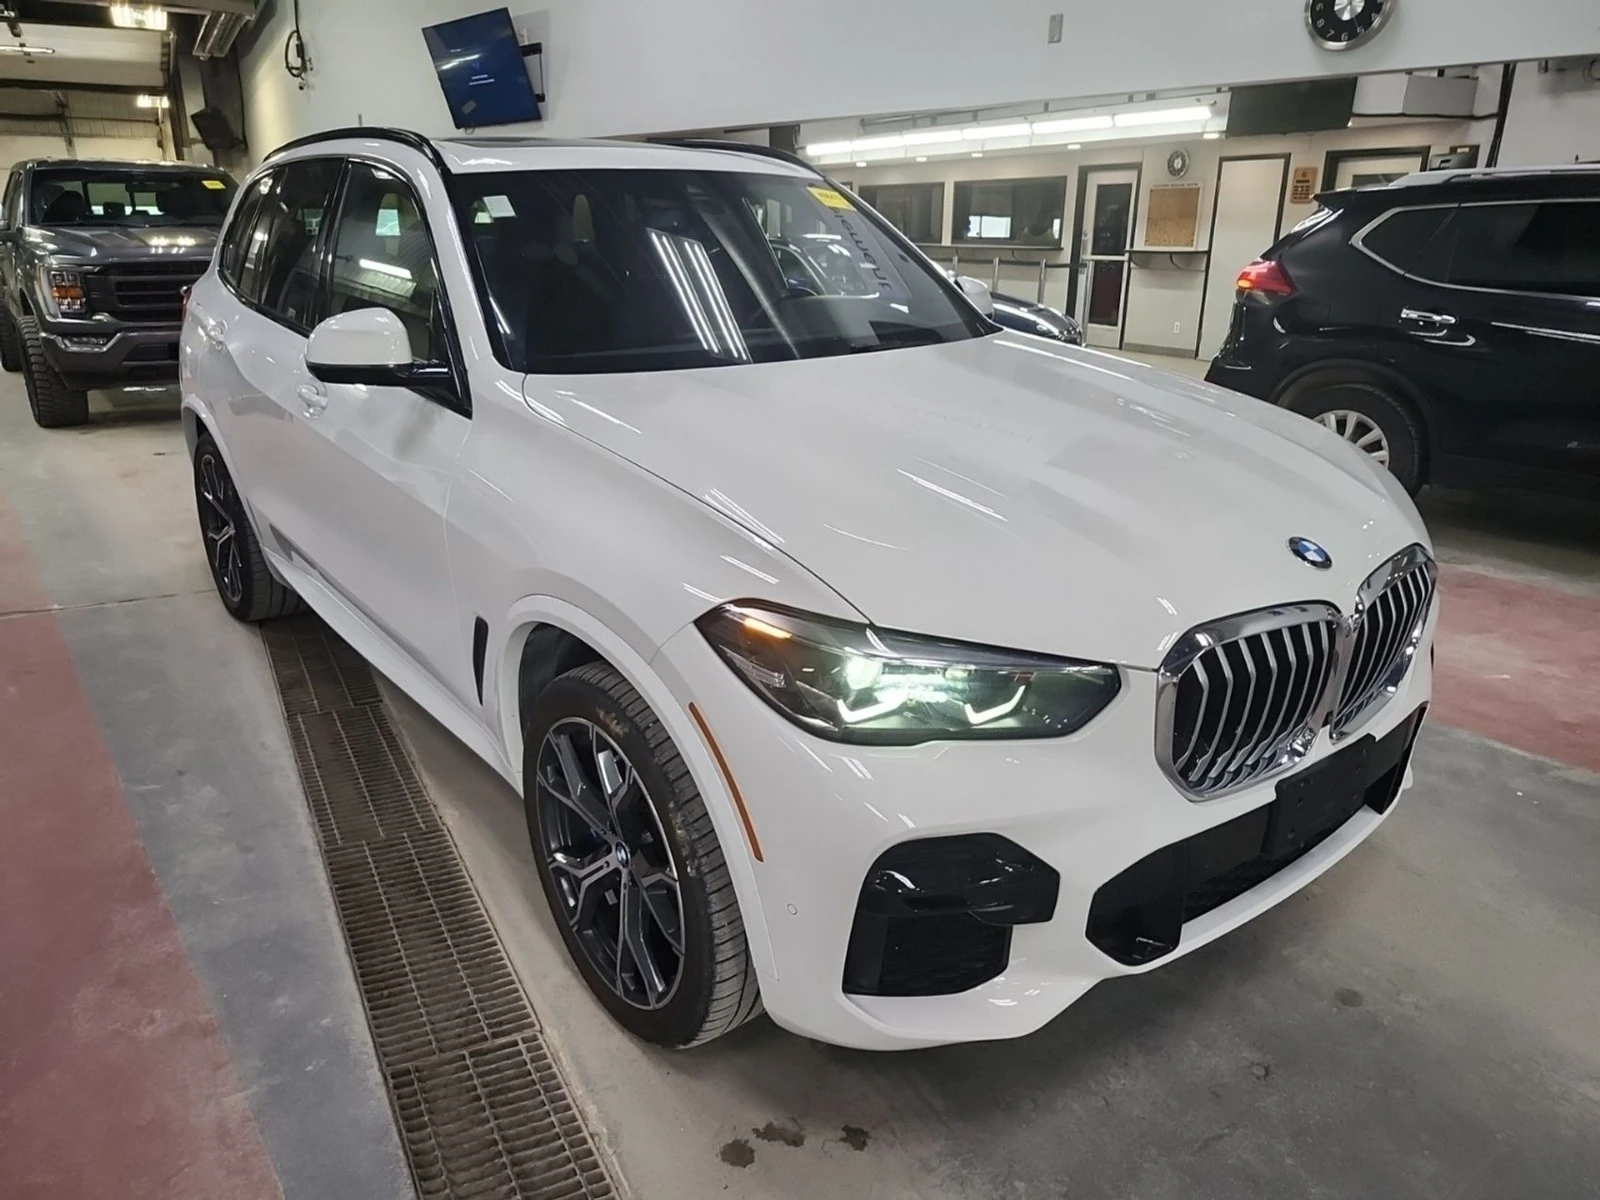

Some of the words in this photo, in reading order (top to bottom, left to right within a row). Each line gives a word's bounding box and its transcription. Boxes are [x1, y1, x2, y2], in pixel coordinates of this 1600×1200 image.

[1317, 19, 1325, 28] 8
[1326, 28, 1336, 38] 7
[1357, 26, 1365, 34] 5
[1341, 32, 1349, 41] 6
